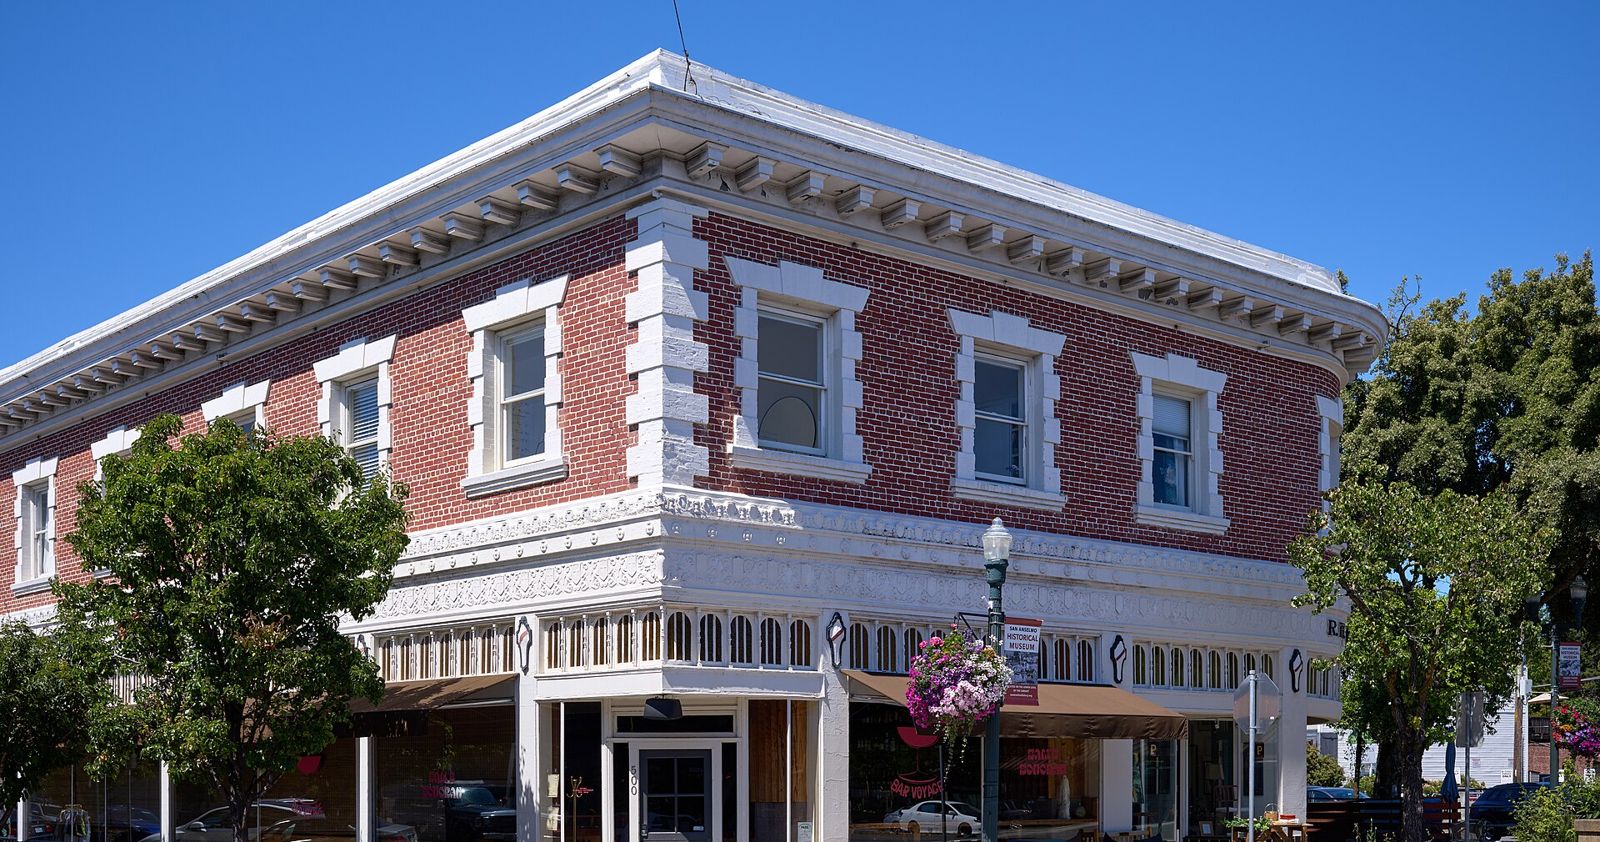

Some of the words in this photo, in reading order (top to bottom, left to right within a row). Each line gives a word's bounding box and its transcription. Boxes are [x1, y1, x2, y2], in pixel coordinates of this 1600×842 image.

[1006, 633, 1038, 642] HISTORICAL
[1009, 642, 1035, 650] MUSEUM
[630, 766, 638, 796] 500
[890, 778, 911, 798] BAR
[911, 780, 945, 800] VOYAGE
